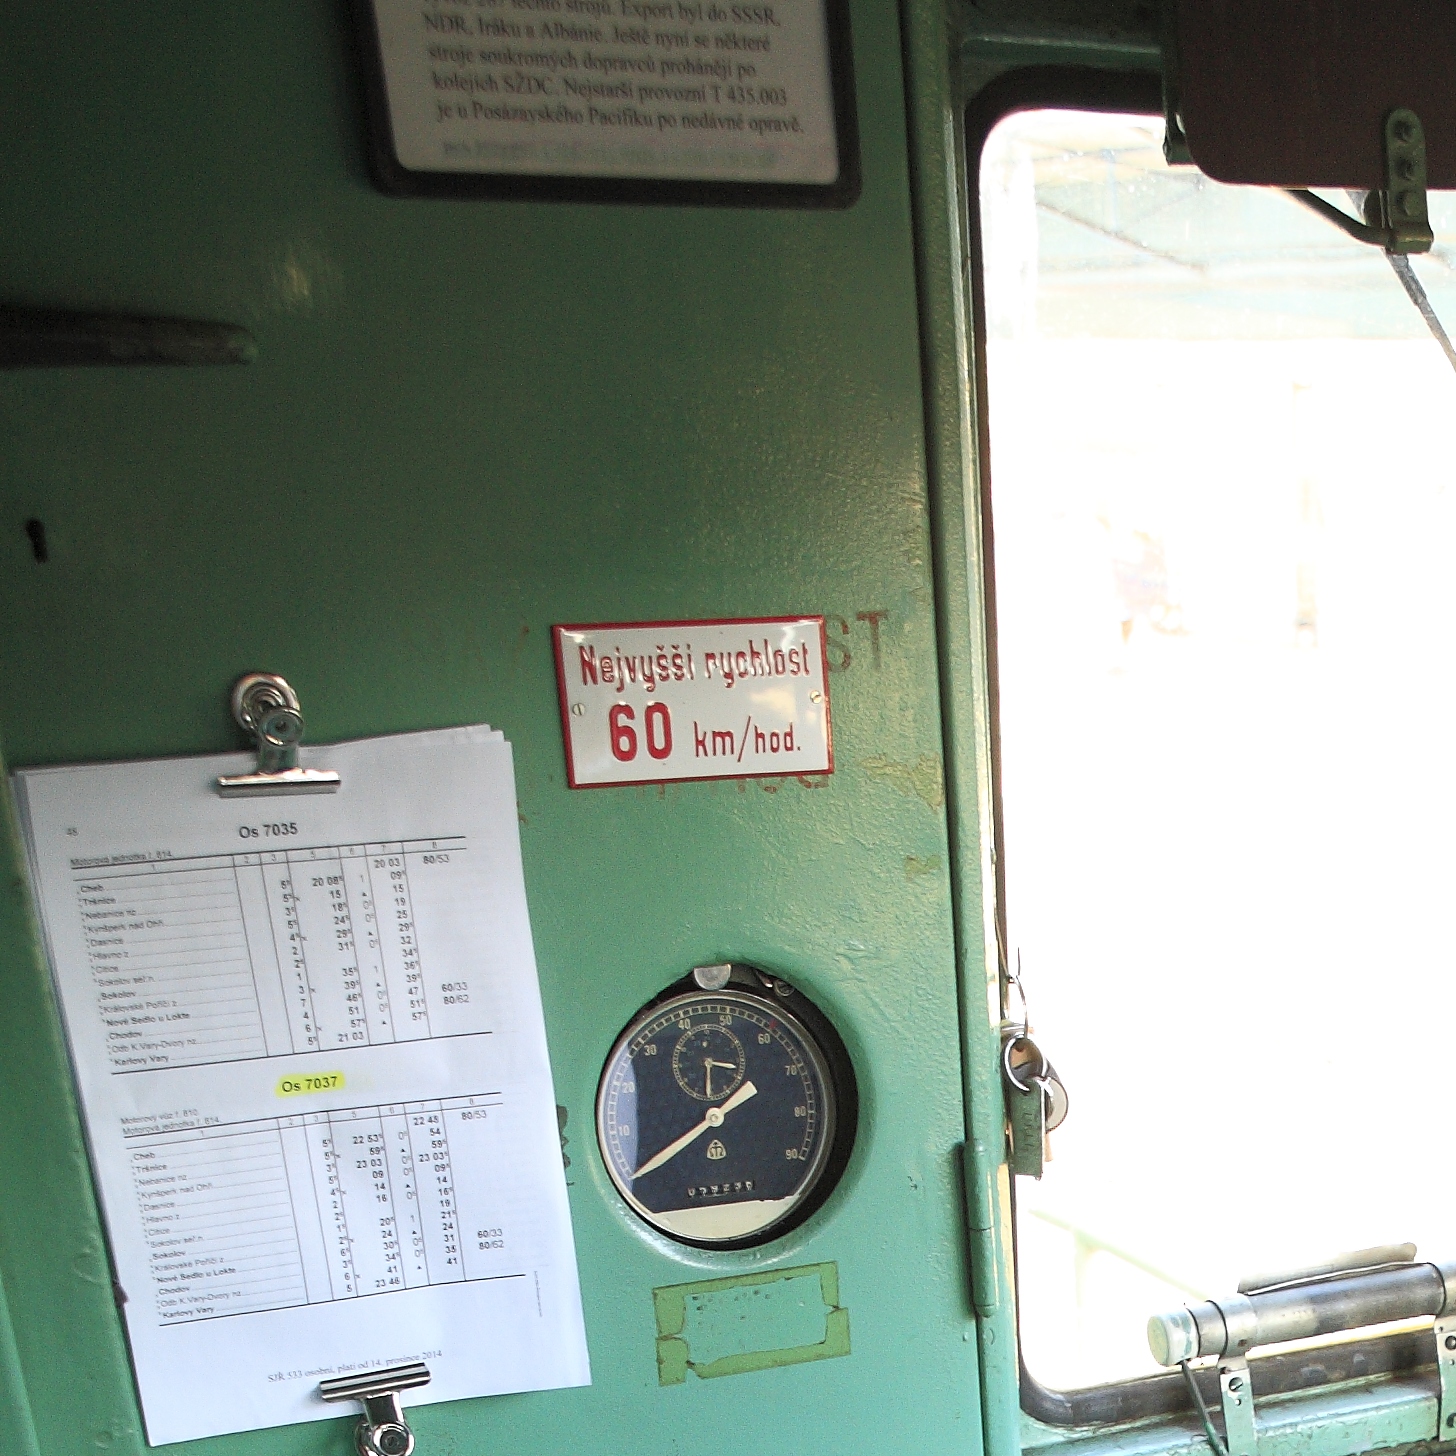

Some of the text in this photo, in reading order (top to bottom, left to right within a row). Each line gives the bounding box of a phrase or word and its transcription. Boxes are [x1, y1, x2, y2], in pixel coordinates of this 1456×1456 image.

[621, 0, 780, 26] Export byl do SSSR,
[525, 25, 535, 38] a
[541, 22, 607, 43] Albánie.
[614, 25, 649, 46] Ještě
[655, 30, 688, 51] nyní
[694, 34, 709, 48] se
[714, 32, 770, 52] některé
[428, 45, 757, 80] stroje soukromých dopravců prohánějí po
[432, 70, 499, 94] kolejích
[563, 77, 632, 102] Nejstarší
[638, 84, 706, 104] provozní
[711, 86, 722, 103] T
[728, 85, 788, 106] 435.003
[437, 100, 804, 136] je u Posázavského Pacifiku po nedávné opravě.
[704, 639, 811, 688] rychlost
[608, 702, 802, 763] 60 km/hod.
[239, 822, 298, 838] Os 7035
[374, 859, 386, 868] 20
[388, 857, 401, 867] 03
[400, 935, 412, 945] 32
[108, 1031, 143, 1041] Chodov
[349, 1007, 360, 1016] 51
[678, 1018, 691, 1031] 40
[719, 1015, 733, 1027] 50
[338, 1033, 350, 1043] 21
[352, 1032, 364, 1041] 03
[757, 1033, 771, 1045] 60
[644, 1044, 657, 1056] 30
[784, 1065, 797, 1076] 70
[281, 1076, 338, 1093] Os 7037
[622, 1082, 635, 1094] 20
[794, 1105, 807, 1118] 80
[618, 1125, 630, 1136] 10
[133, 1152, 156, 1161] Cheb
[413, 1116, 425, 1126] 22
[352, 1135, 365, 1145] 22
[356, 1153, 430, 1169] 23 03 23
[785, 1149, 798, 1161] 90
[375, 1176, 448, 1191] 14 14
[382, 1230, 393, 1239] 24
[387, 1265, 398, 1274] 41
[158, 1285, 190, 1296] Chodov
[196, 1305, 215, 1315] Vary
[376, 1279, 387, 1288] 23
[287, 1369, 304, 1380] 533
[358, 1360, 370, 1371] od
[385, 1354, 421, 1368] prosince
[422, 1349, 443, 1360] 2014
